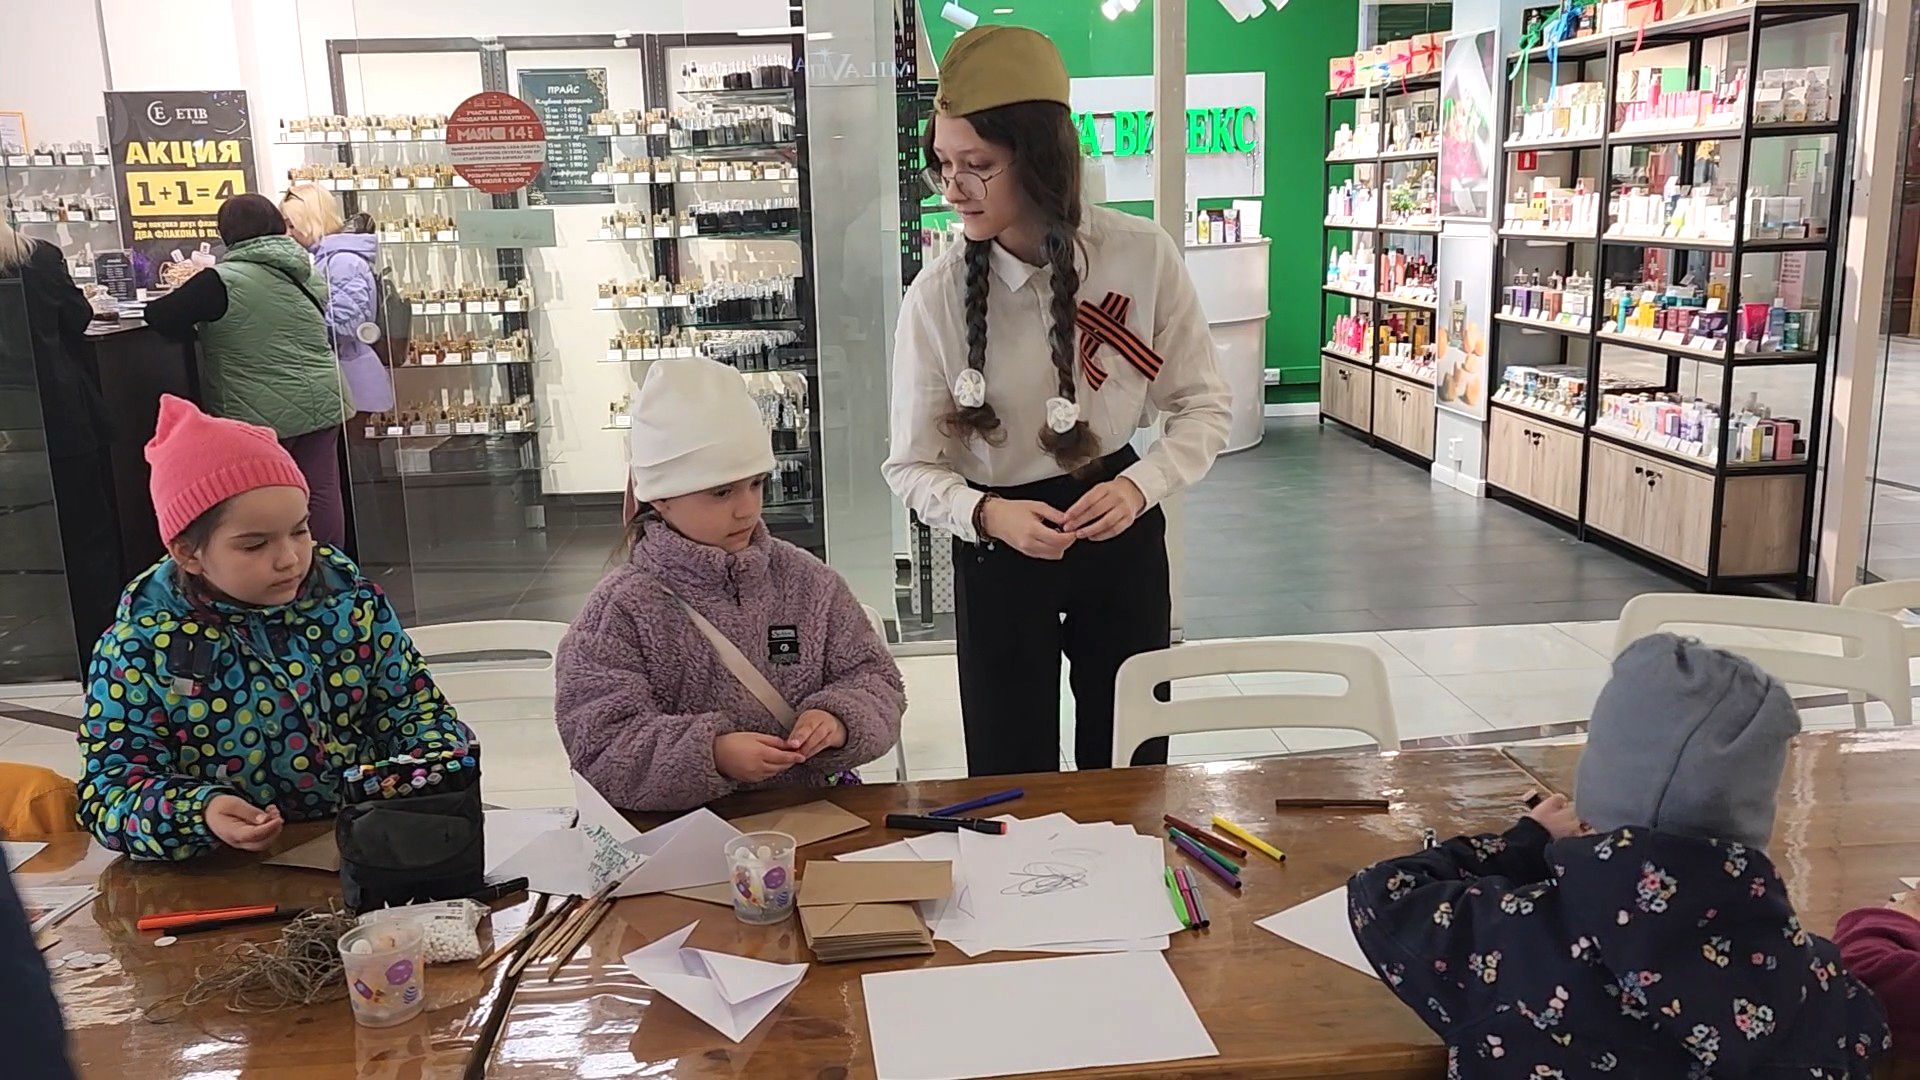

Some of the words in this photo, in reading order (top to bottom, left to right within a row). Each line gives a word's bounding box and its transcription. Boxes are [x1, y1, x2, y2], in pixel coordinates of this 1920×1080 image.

[547, 84, 580, 94] ПРАЙС
[175, 107, 208, 120] ETIB
[508, 126, 526, 140] 14
[126, 139, 241, 168] АКЦИЯ
[134, 230, 153, 241] ДВА
[154, 228, 198, 239] ФЛАКОНА
[198, 229, 206, 238] В
